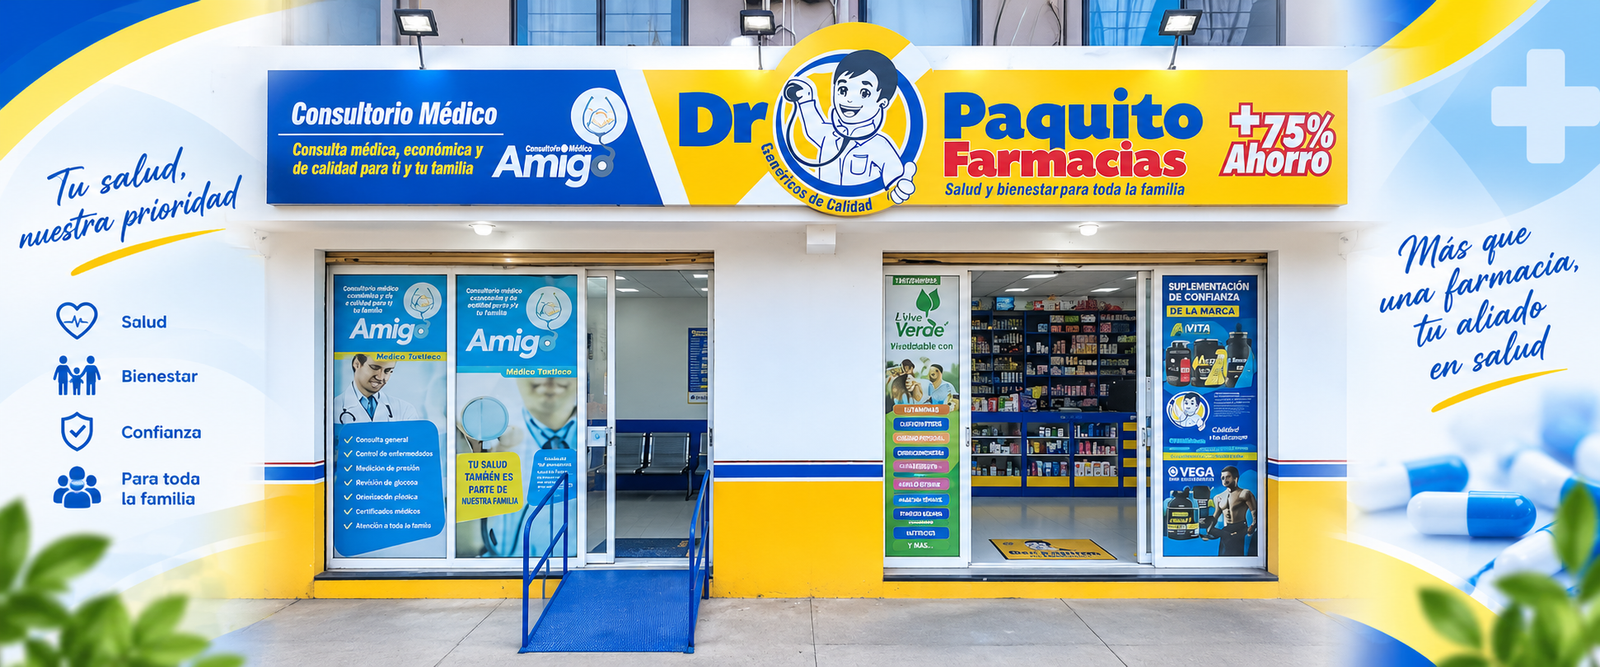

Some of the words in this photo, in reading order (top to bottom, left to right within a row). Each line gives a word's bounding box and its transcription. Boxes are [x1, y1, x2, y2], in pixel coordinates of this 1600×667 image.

[291, 101, 413, 126] Consultorio
[418, 101, 498, 126] Médico
[679, 92, 769, 147] Dr
[943, 87, 1204, 150] Paquito
[292, 142, 348, 158] Consulta
[351, 142, 401, 159] médica,
[403, 142, 472, 158] económica
[474, 146, 484, 160] y
[943, 140, 1188, 178] Farmacias
[1218, 141, 1332, 177] Ahorro
[292, 162, 305, 176] de
[306, 162, 358, 176] calidad
[360, 165, 390, 178] para
[392, 162, 402, 175] ti
[403, 165, 413, 178] y
[415, 163, 428, 175] tu
[430, 162, 474, 176] familia
[491, 145, 616, 188] Amigo
[945, 182, 982, 196] Salud
[985, 186, 995, 198] y
[996, 182, 1059, 196] bienestar
[1059, 185, 1089, 198] para
[1092, 182, 1122, 196] toda
[1125, 182, 1138, 196] la
[1140, 182, 1186, 196] familia
[808, 193, 824, 207] de
[827, 197, 873, 213] Calidad
[1168, 280, 1250, 291] SUPLEMENTACIÓN
[1169, 293, 1182, 301] DE
[1184, 293, 1240, 301] CONFIANZA
[1170, 307, 1183, 315] DE
[1185, 307, 1198, 315] LA
[1200, 307, 1235, 315] MARCA
[349, 317, 431, 346] Amigo
[465, 328, 558, 359] Amigo
[384, 436, 409, 445] general
[386, 464, 395, 472] de
[468, 460, 479, 469] TU
[481, 460, 508, 469] SALUD
[1179, 466, 1215, 477] VEGA
[502, 473, 514, 481] ES
[468, 485, 495, 494] PARTE
[497, 485, 508, 494] DE
[461, 497, 492, 505] NUESTRA
